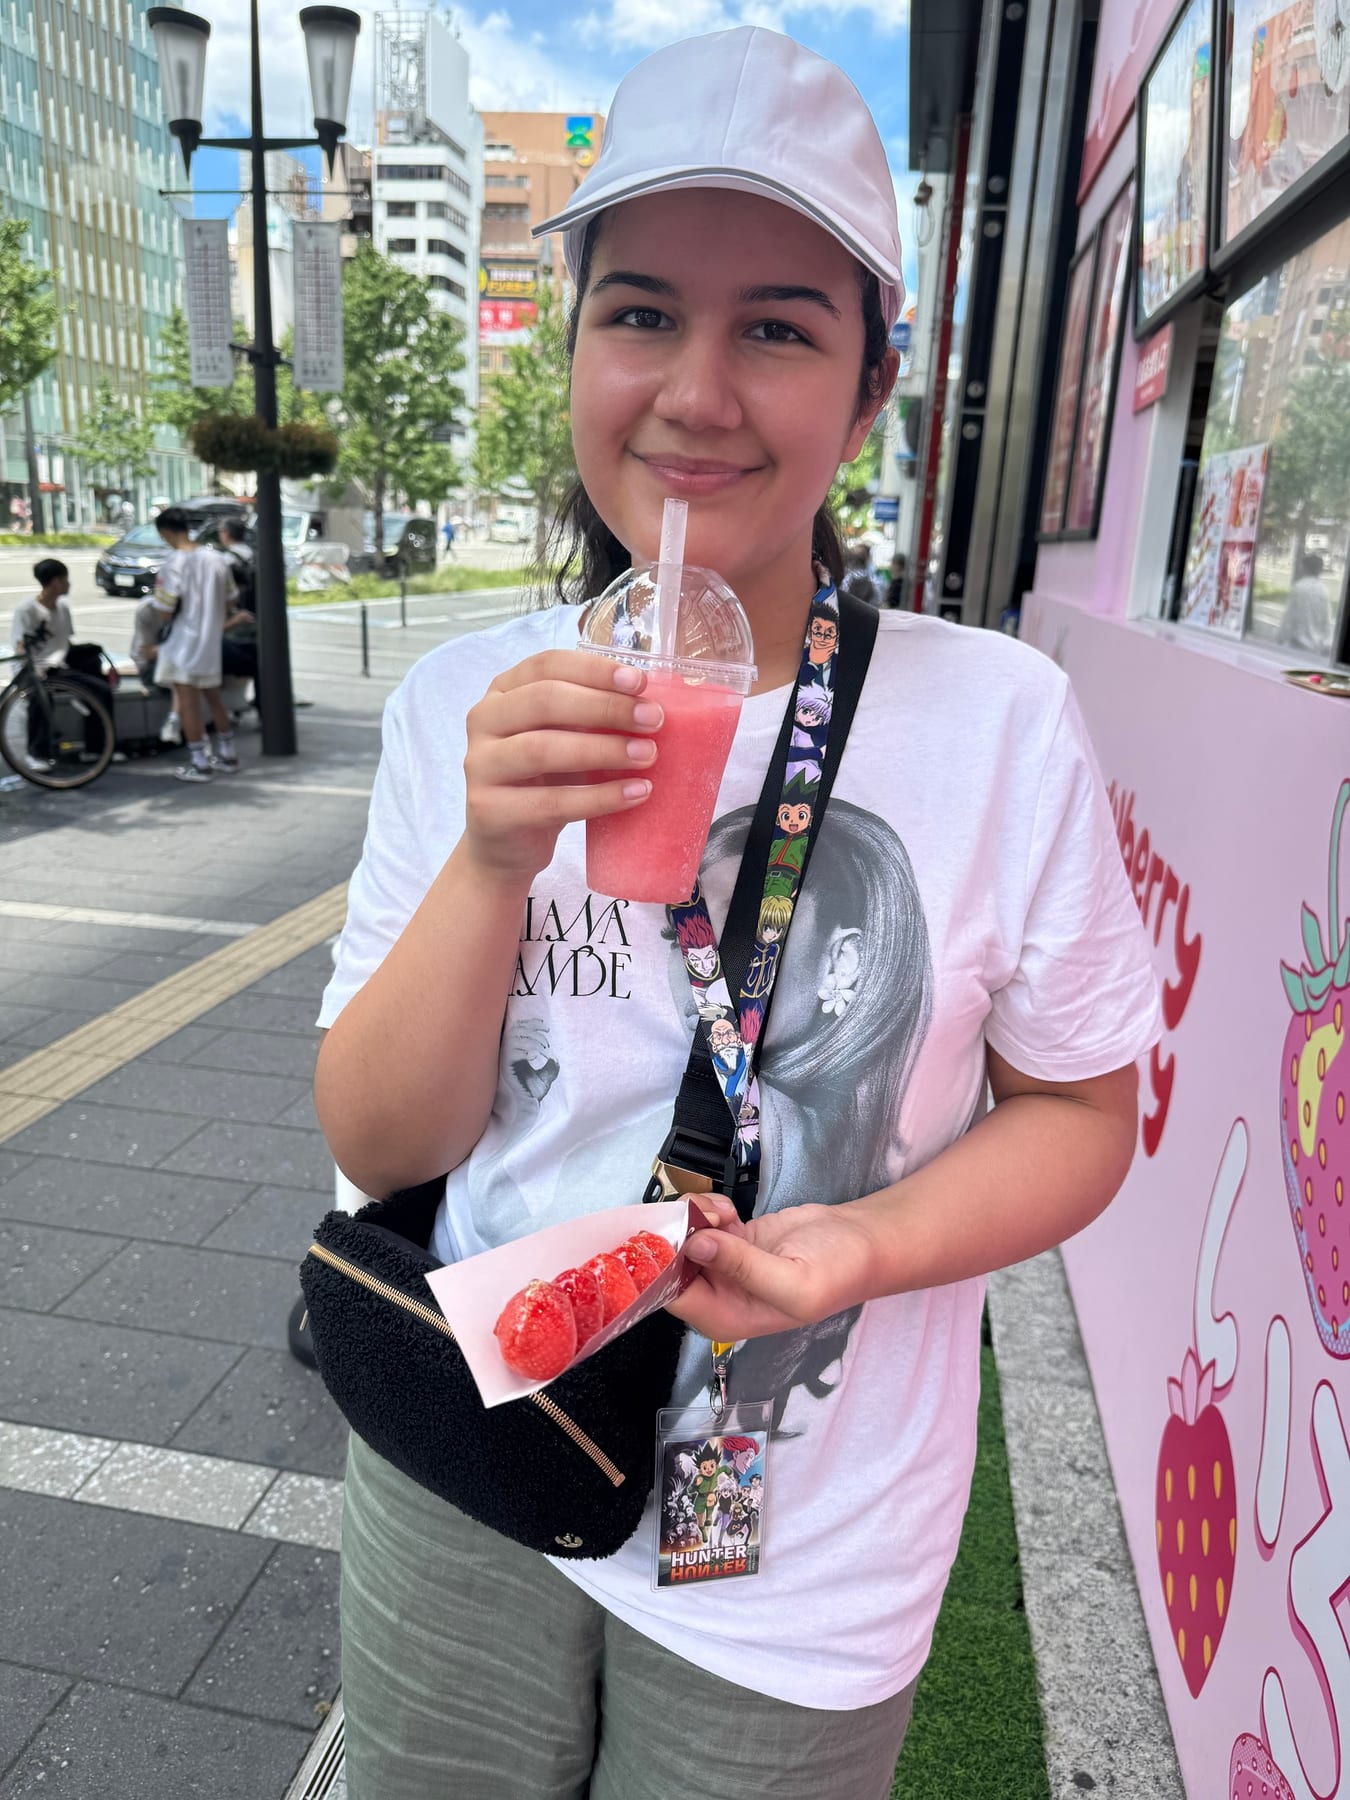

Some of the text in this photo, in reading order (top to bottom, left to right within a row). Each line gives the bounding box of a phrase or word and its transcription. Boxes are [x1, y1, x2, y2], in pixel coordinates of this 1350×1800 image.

[519, 893, 632, 947] IANA
[508, 943, 632, 1000] ANDE
[671, 1546, 747, 1567] HUNTER
